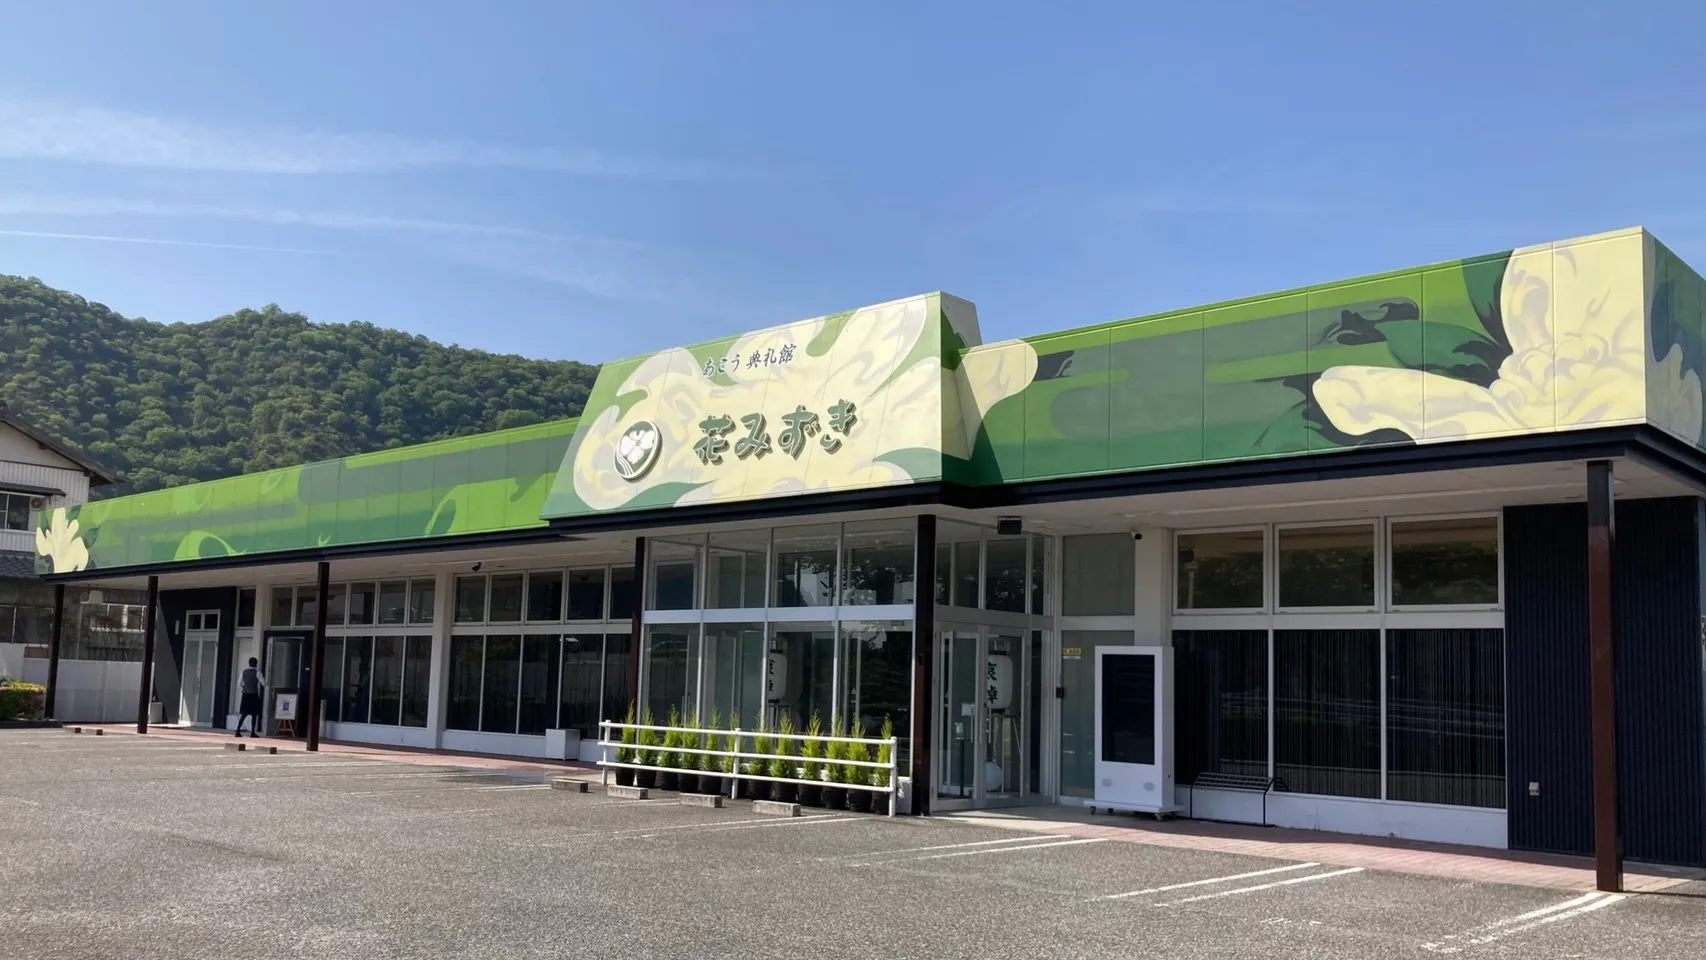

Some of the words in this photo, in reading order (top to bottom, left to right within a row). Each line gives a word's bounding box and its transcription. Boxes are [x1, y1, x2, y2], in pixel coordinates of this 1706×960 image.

[702, 353, 740, 377] あこう
[746, 343, 797, 370] 典礼館
[693, 398, 858, 466] 花みずき
